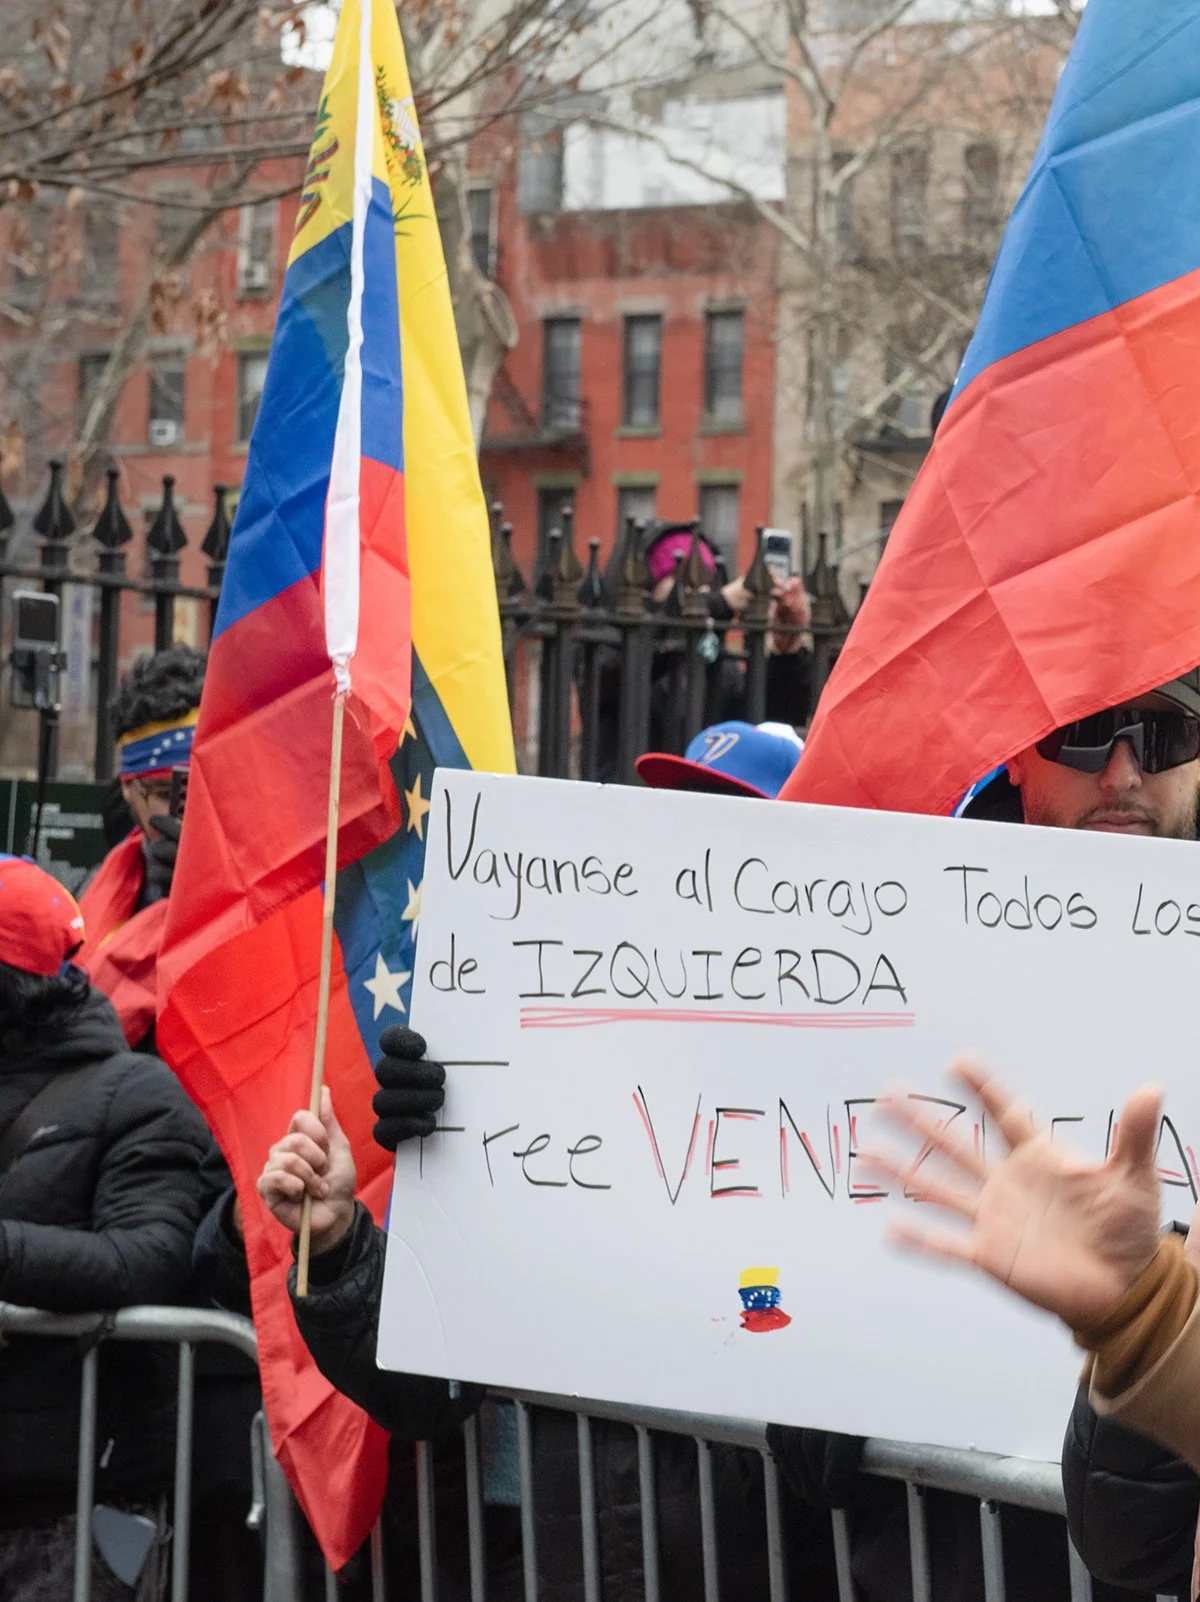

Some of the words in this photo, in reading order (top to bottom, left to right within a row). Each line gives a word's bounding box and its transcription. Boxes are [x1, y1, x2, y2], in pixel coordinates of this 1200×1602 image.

[444, 788, 638, 920] Vayanse
[675, 848, 713, 912] al
[734, 858, 908, 936] Carajo
[943, 865, 1098, 931] Todos
[429, 933, 486, 994] de
